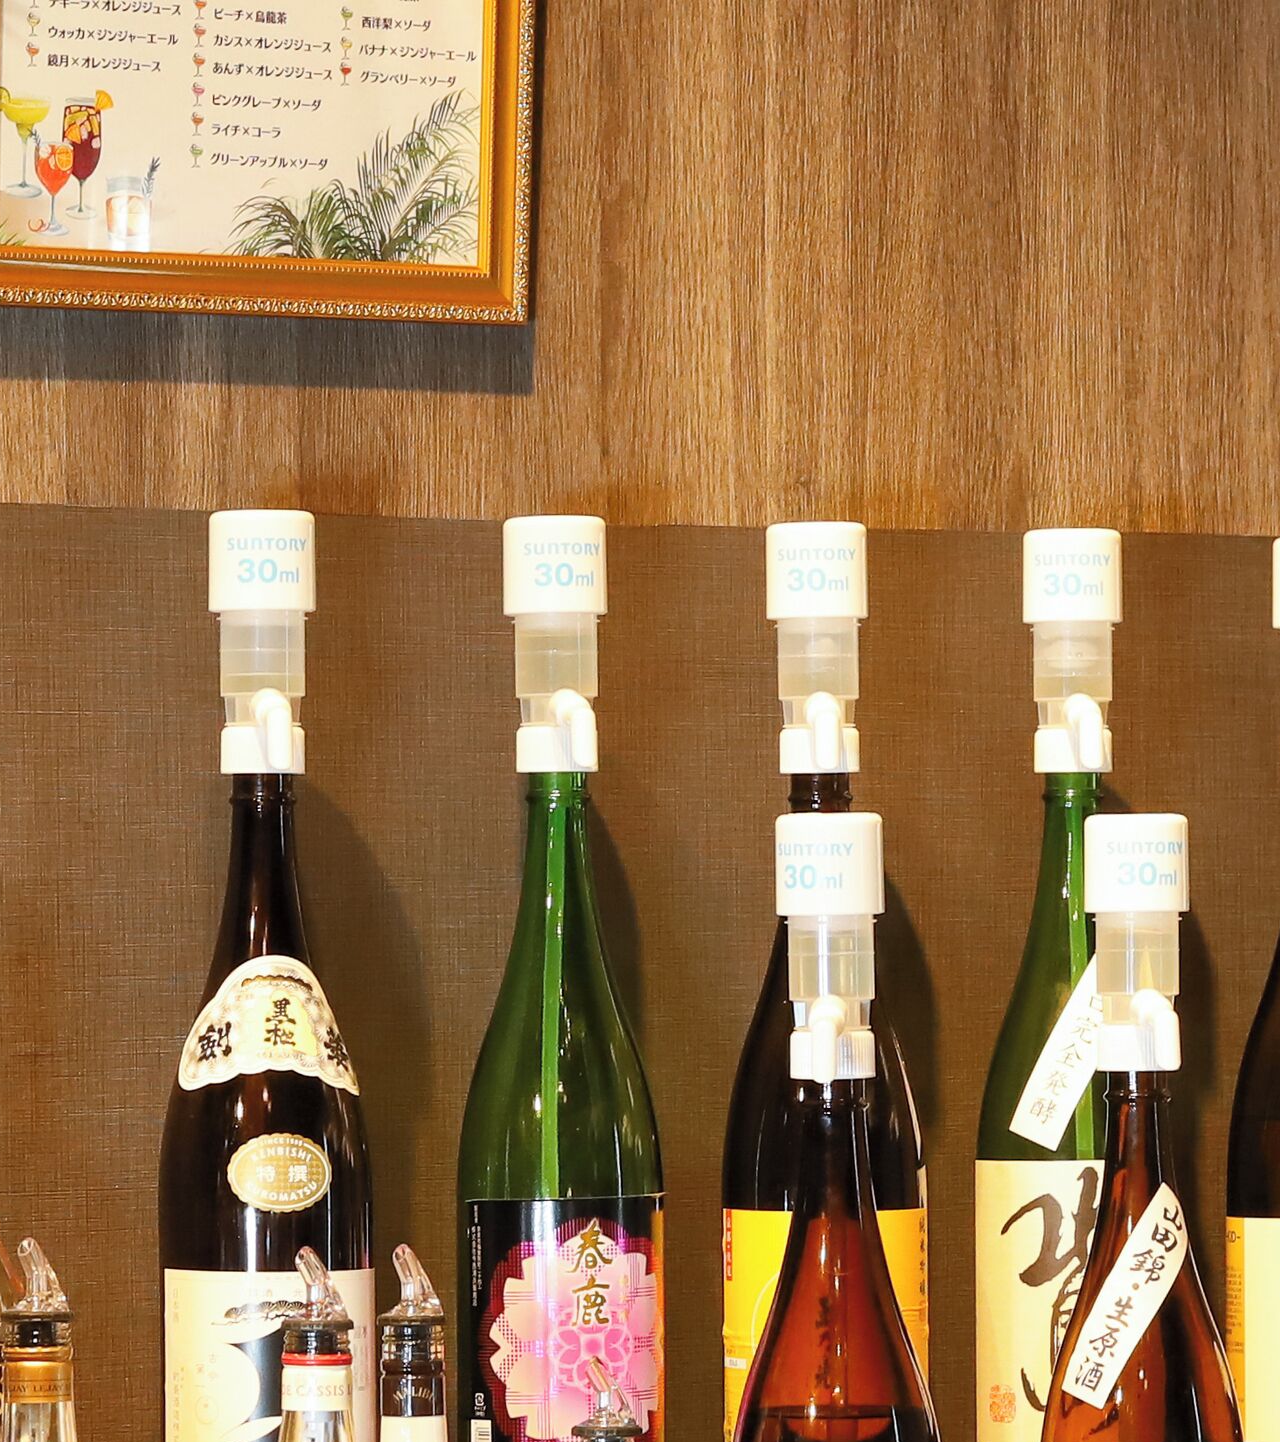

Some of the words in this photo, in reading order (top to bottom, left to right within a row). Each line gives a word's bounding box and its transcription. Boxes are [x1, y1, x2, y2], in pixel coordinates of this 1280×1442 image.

[213, 9, 288, 25] ピーチ×烏龍茶
[361, 16, 431, 31] 西洋梨×ソーダ
[47, 26, 179, 46] ウォッカ×ジンジャーエール
[213, 35, 332, 53] カシス×オレンジジュース
[47, 53, 161, 73] 鏡月×オレンジジュース
[358, 44, 477, 62] バナナ×ジンジャーエール
[212, 62, 333, 81] あんず×オレンジジュース
[210, 123, 281, 139] ライチ×コーラ
[209, 152, 328, 170] グリーンアップル×ソーダ
[237, 558, 300, 584] 30ml
[533, 563, 595, 588] 30ml
[787, 568, 849, 592] 30ml
[1043, 573, 1104, 598] 30ml
[784, 864, 844, 890] 30ml
[1117, 862, 1178, 887] 30ml
[567, 1217, 613, 1327] 春鹿
